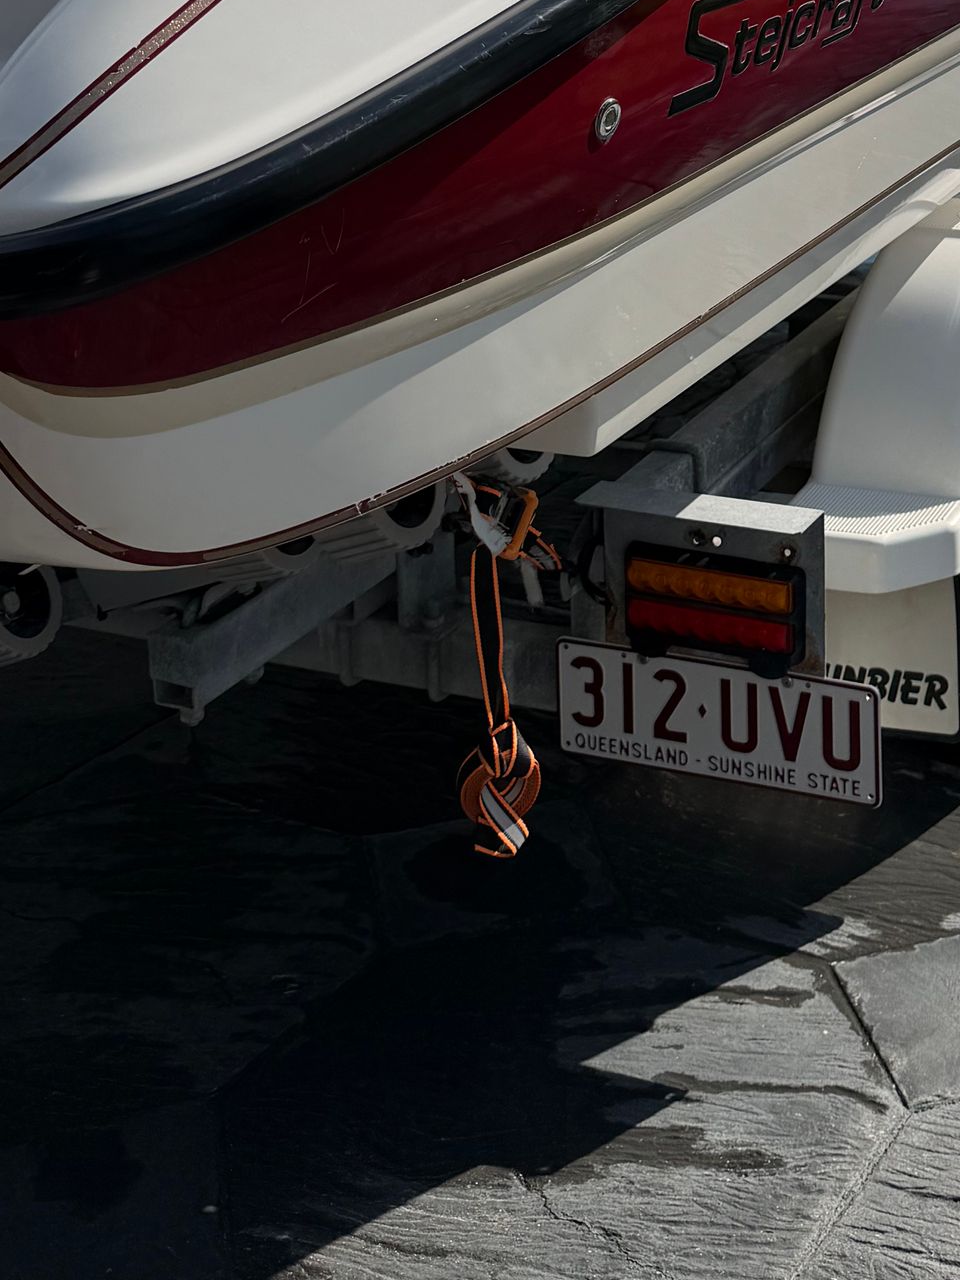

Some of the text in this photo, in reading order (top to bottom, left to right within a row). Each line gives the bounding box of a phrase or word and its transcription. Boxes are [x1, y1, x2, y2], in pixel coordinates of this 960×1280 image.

[575, 732, 689, 767] QUEENSLAND
[708, 755, 797, 786] SUNSHINE
[807, 773, 861, 798] STATE
